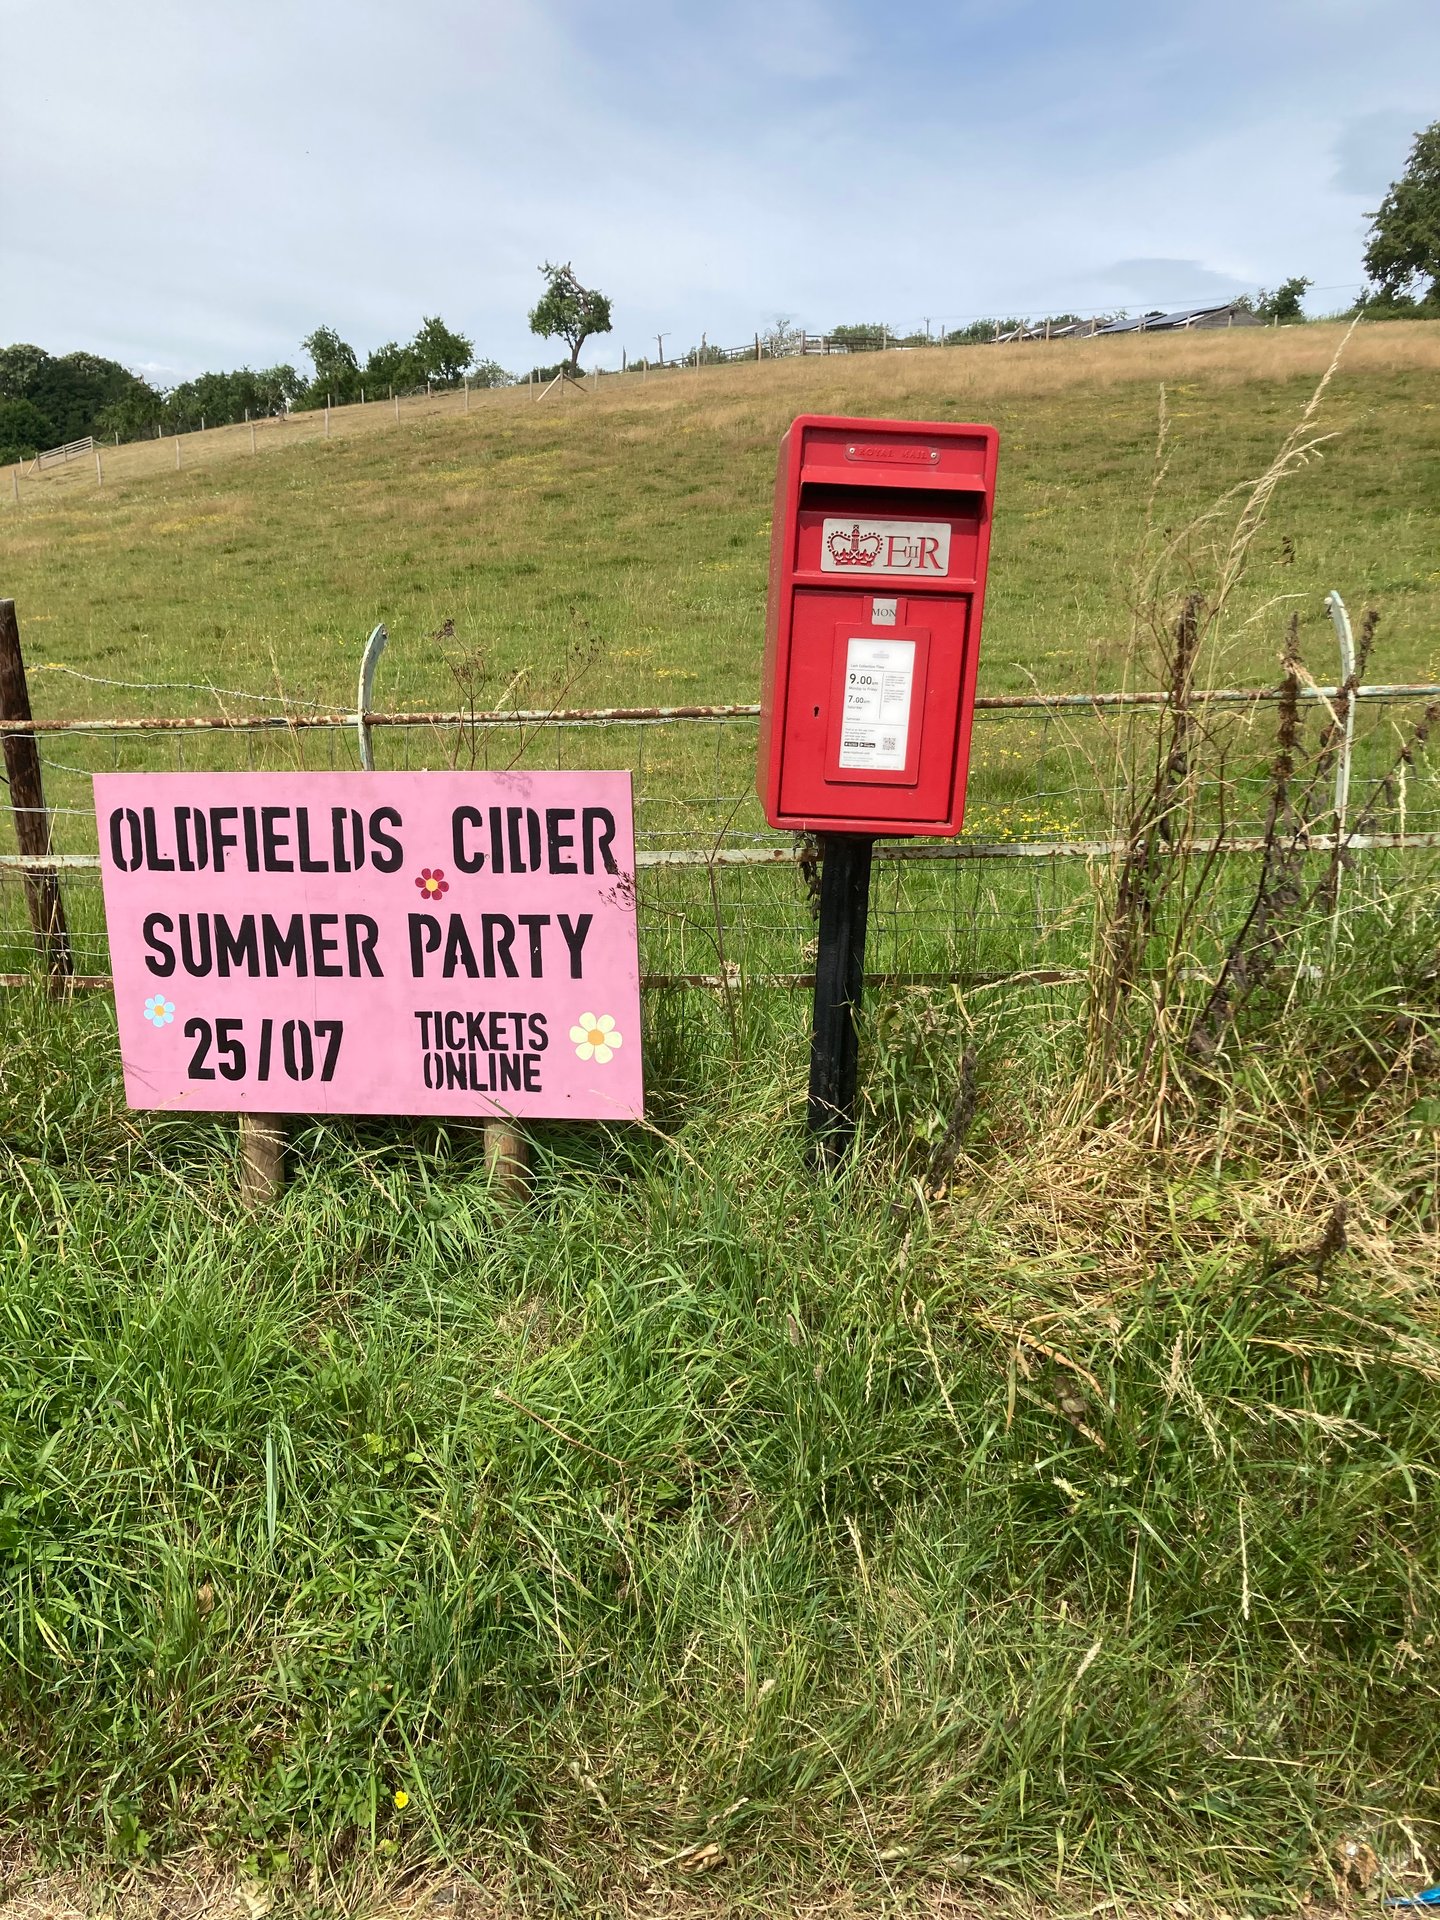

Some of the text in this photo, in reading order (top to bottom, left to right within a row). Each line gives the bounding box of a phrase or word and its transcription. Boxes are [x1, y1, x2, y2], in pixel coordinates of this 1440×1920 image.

[858, 447, 928, 460] ROYAL MAIL
[872, 608, 896, 616] MON
[110, 805, 619, 874] OLDFIELDS CIDER
[143, 912, 594, 979] SUMMER PARTY
[184, 1017, 344, 1082] 25/07
[414, 1011, 549, 1052] TICKETS
[424, 1052, 542, 1093] ONLINE
